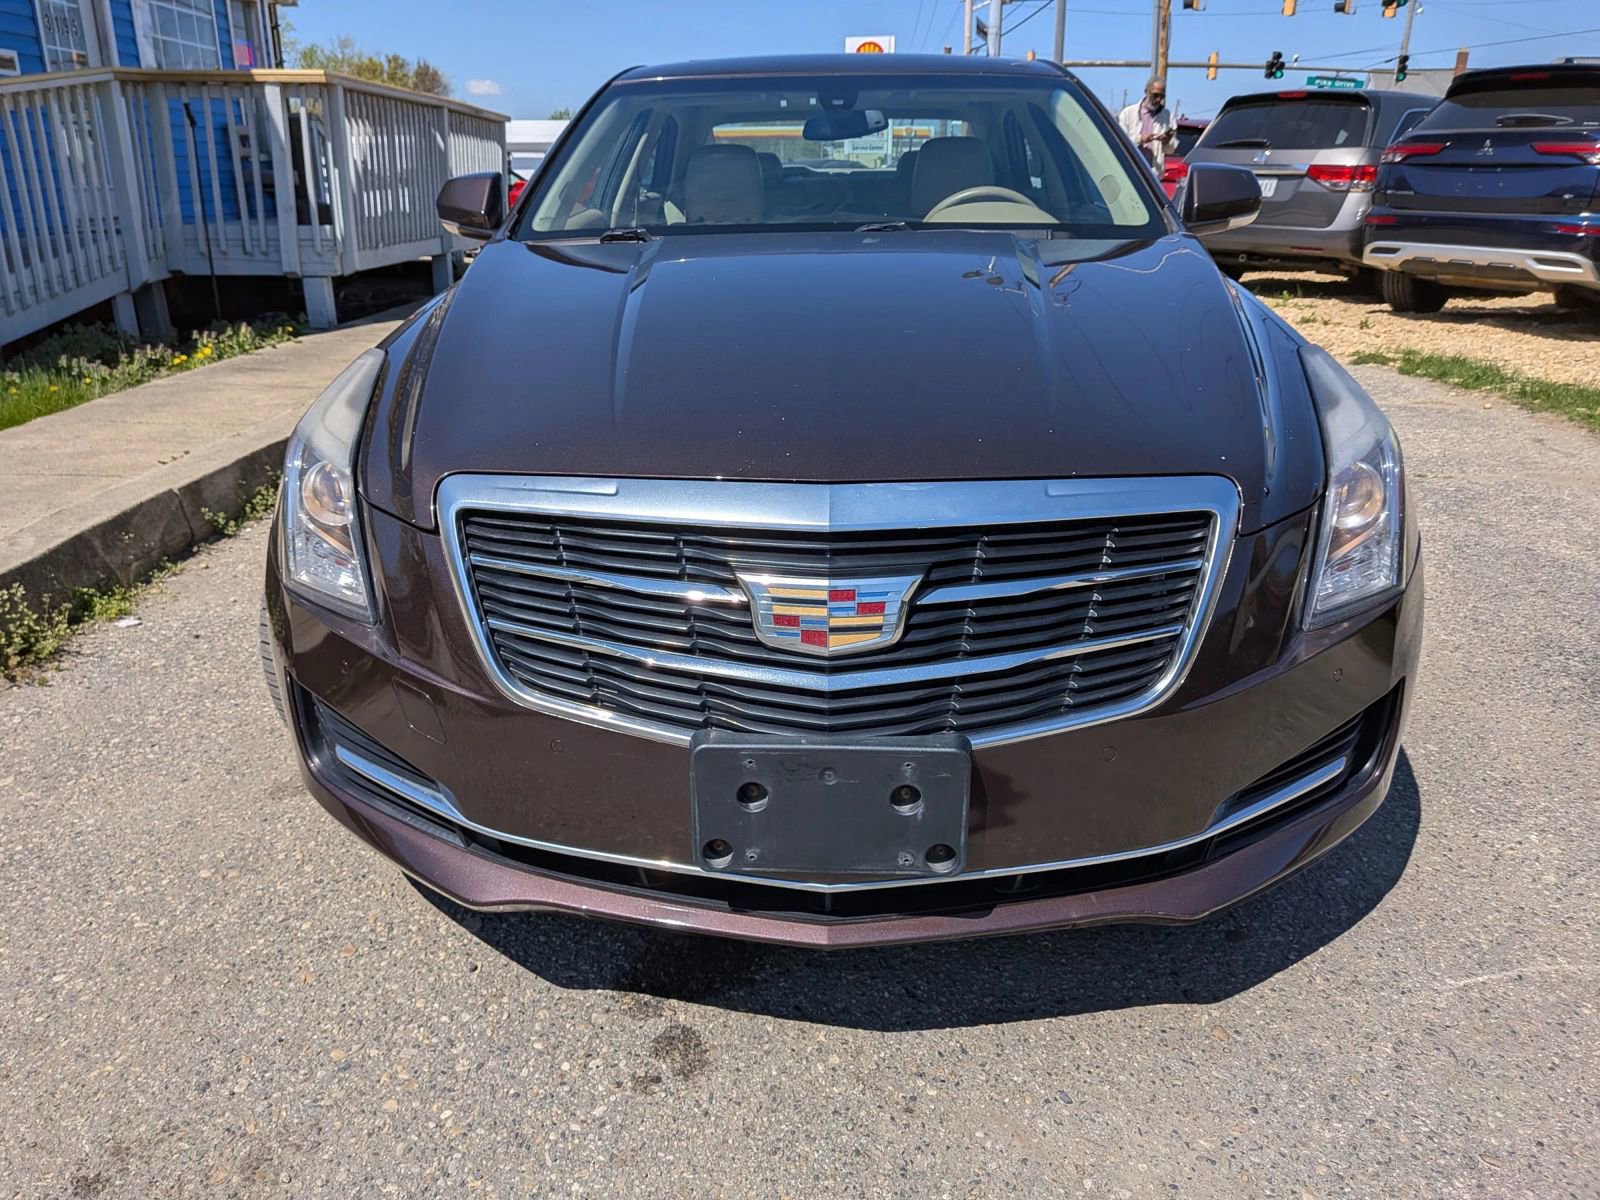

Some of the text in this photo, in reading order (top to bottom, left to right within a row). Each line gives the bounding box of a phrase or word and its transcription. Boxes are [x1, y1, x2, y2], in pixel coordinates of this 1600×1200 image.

[44, 13, 78, 36] 3195
[1315, 79, 1356, 88] Pike Drive
